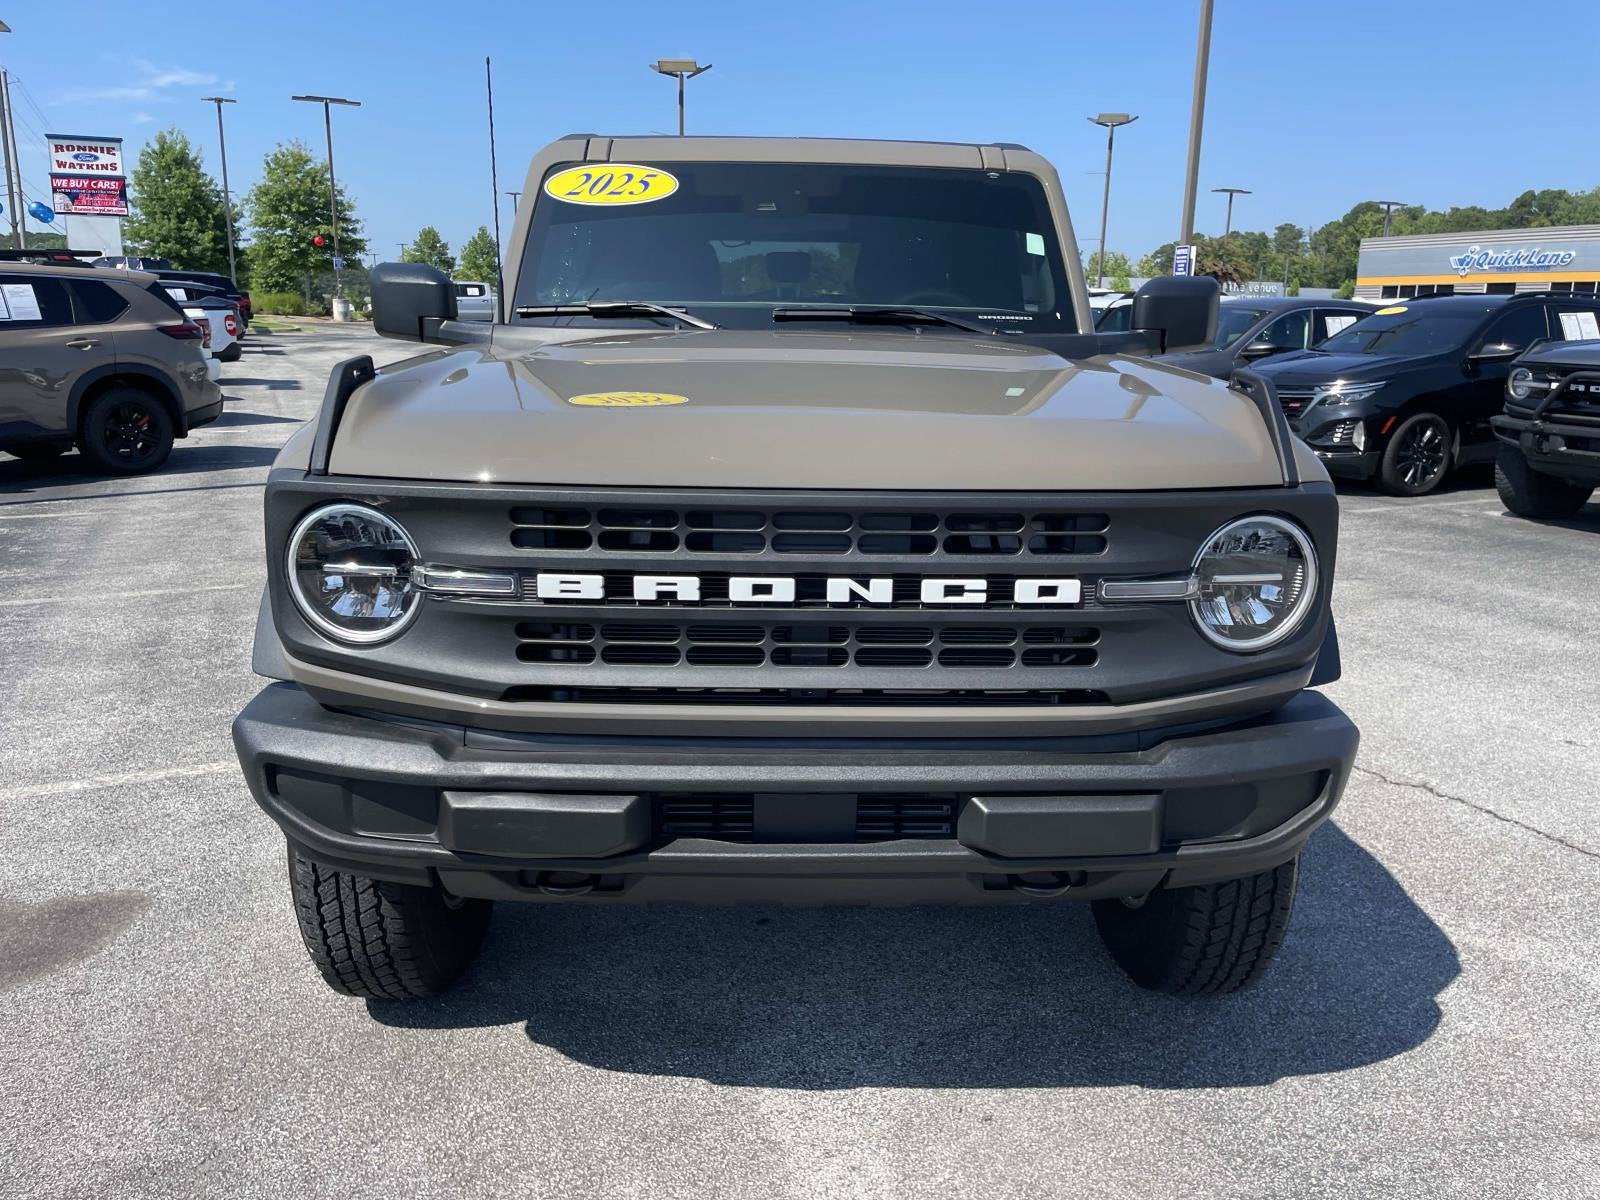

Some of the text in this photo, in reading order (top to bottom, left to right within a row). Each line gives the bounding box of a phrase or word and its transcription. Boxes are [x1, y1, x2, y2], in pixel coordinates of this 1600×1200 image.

[53, 144, 117, 156] RONNIE
[77, 153, 96, 162] Ford
[55, 159, 118, 171] WATKINS
[52, 178, 119, 189] WE BUY CARS!
[566, 172, 658, 197] 2025
[1475, 248, 1574, 269] Quick Lane
[536, 572, 1081, 604] BRONCO
